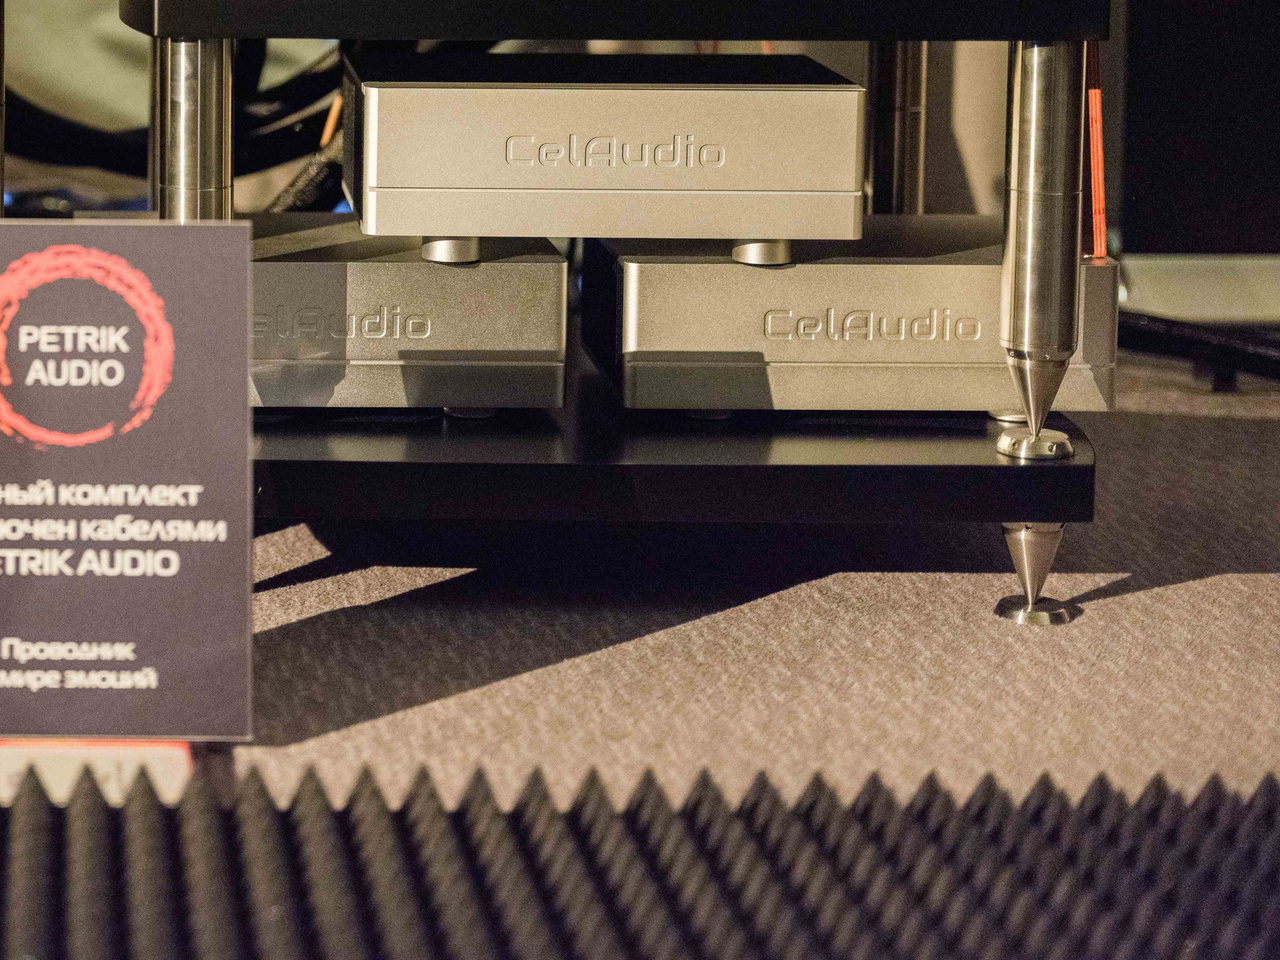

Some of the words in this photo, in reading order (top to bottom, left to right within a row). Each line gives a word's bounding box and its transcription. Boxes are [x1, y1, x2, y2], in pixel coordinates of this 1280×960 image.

[505, 134, 726, 168] CelAudio
[250, 305, 431, 339] elAudio
[763, 307, 982, 341] CelAudio
[18, 325, 130, 354] PETRIK
[25, 358, 125, 387] AUDIO
[58, 483, 205, 507] комплект
[80, 513, 228, 542] кабелями
[75, 548, 181, 578] AUDIO
[0, 636, 137, 664] Проводник
[63, 666, 159, 690] эмоций
